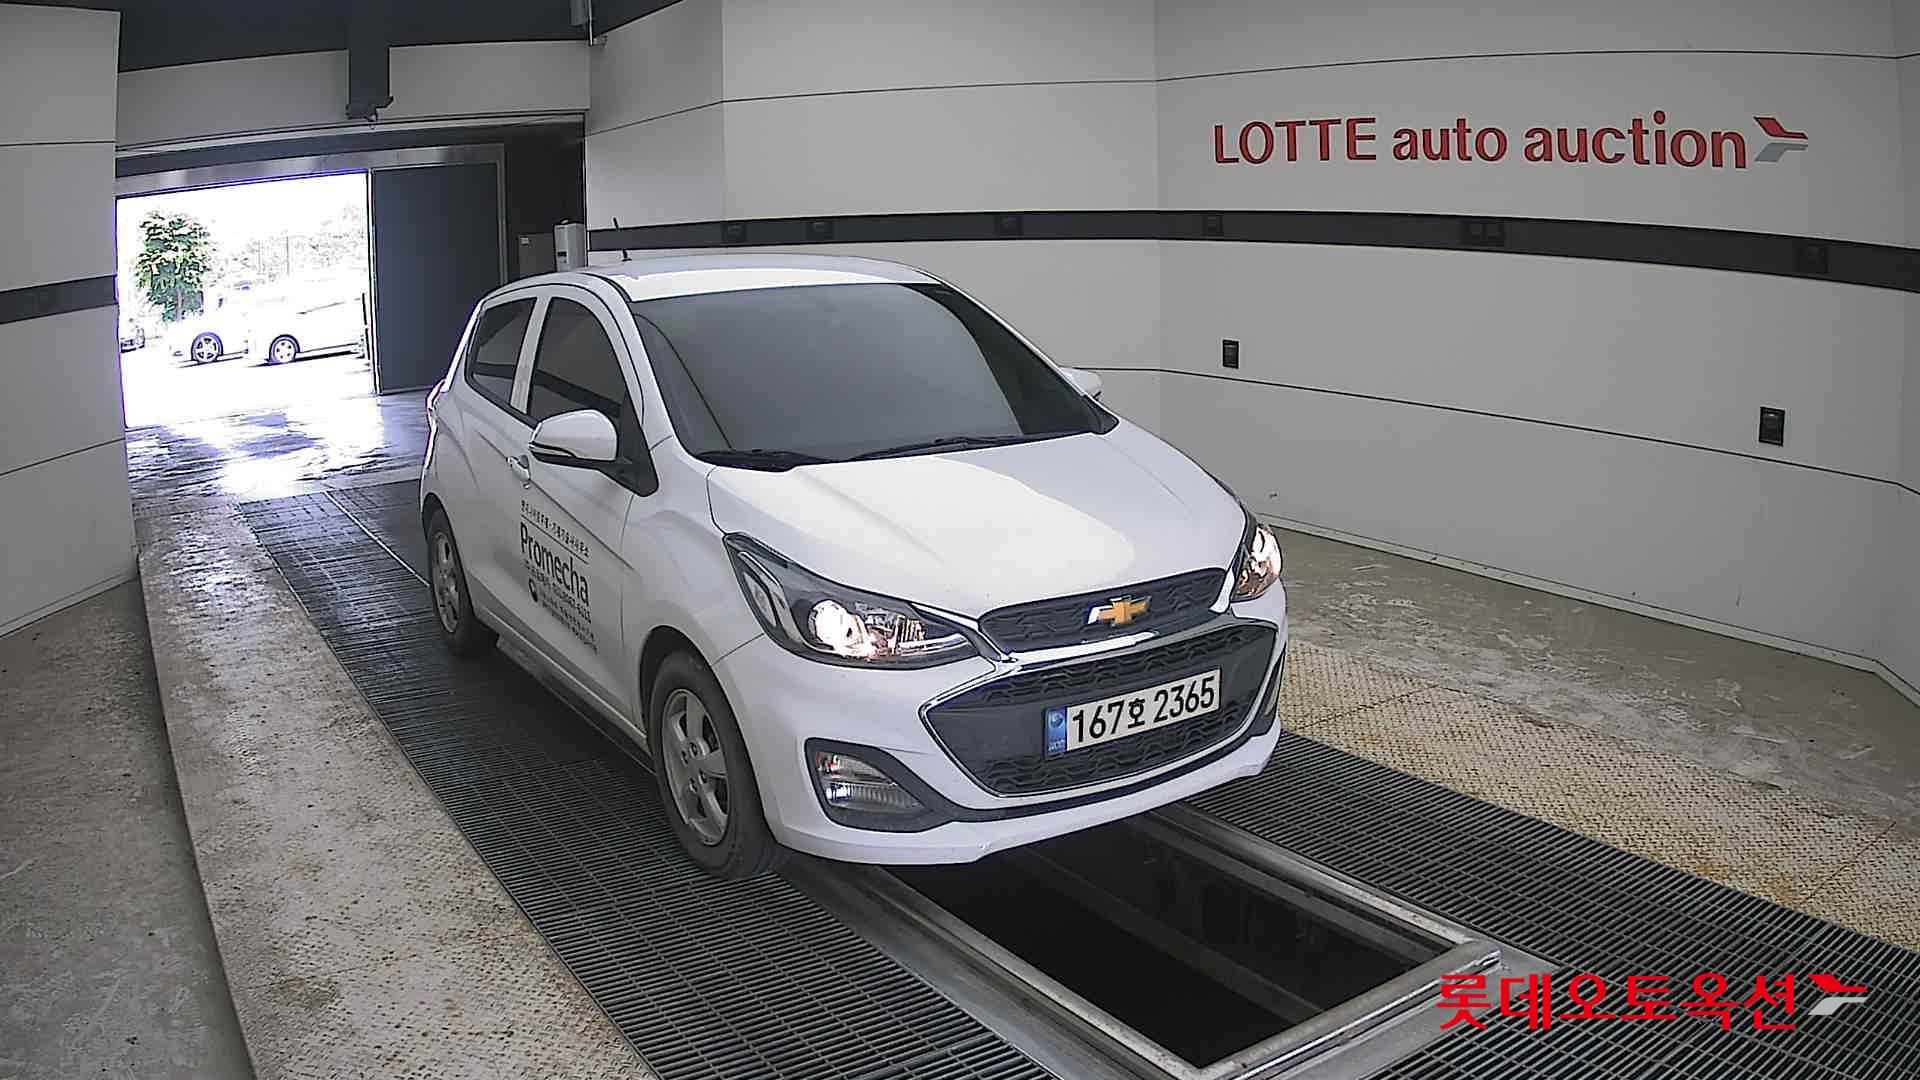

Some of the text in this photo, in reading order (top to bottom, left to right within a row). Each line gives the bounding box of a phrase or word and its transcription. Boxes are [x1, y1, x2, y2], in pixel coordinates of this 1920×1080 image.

[1213, 110, 1747, 169] LOTTE auto auction
[520, 521, 590, 606] Promecha
[1072, 675, 1215, 743] 167호 2365
